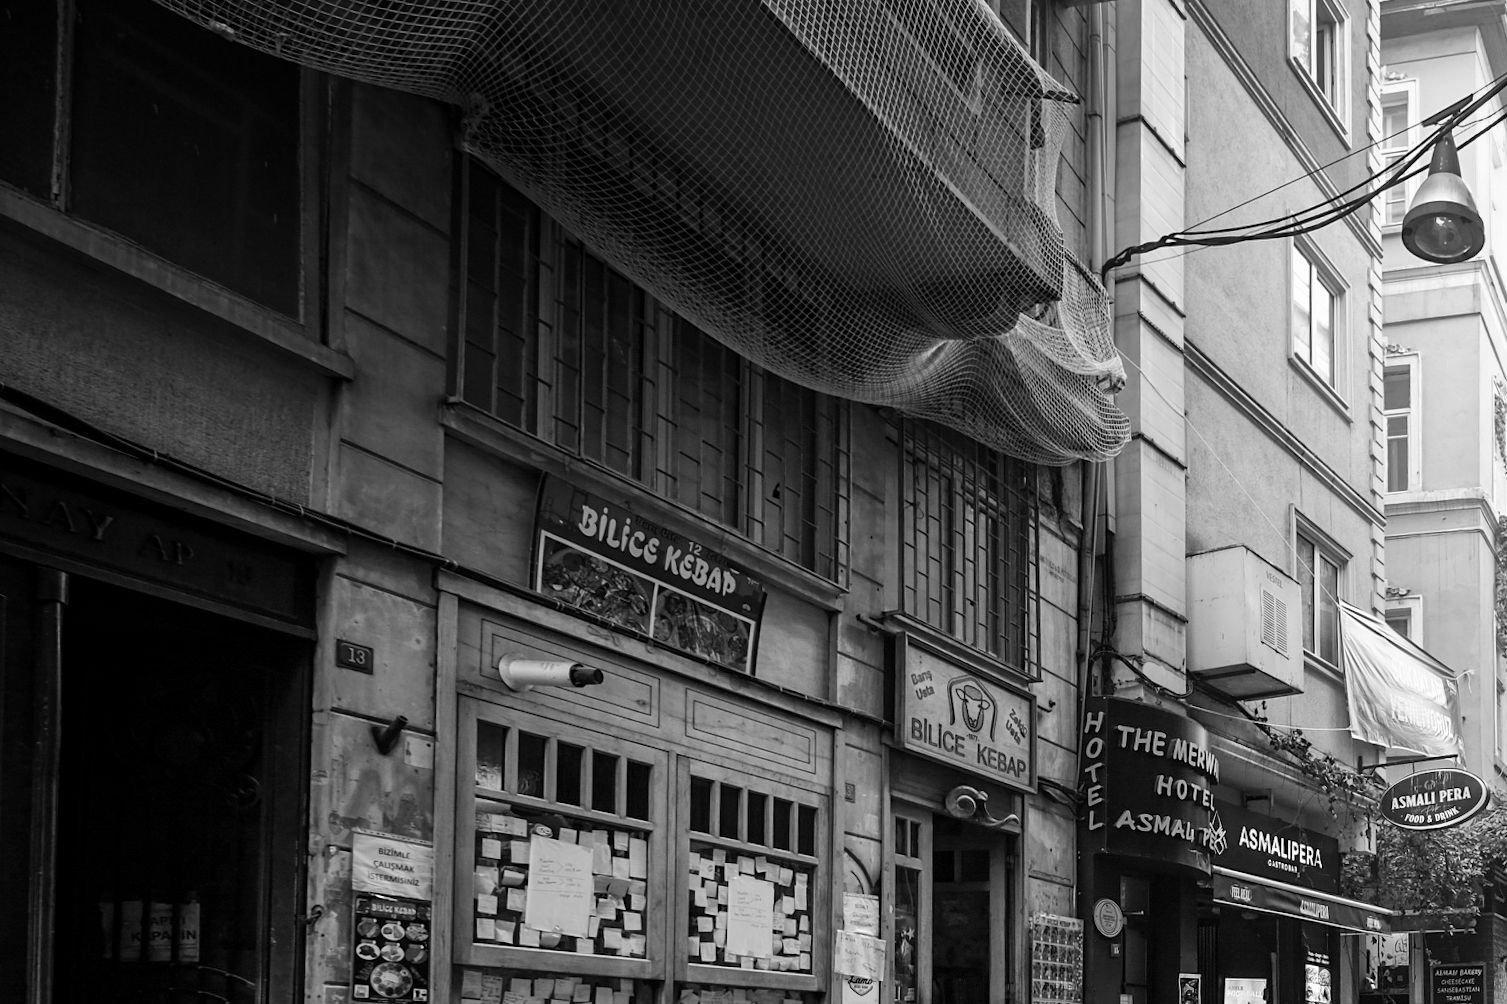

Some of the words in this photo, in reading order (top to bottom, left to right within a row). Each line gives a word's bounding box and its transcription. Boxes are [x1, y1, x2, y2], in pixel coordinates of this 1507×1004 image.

[578, 504, 660, 564] BİLİCE
[664, 544, 737, 597] KEBAP
[347, 647, 367, 665] 13
[915, 685, 936, 701] Usta
[1115, 724, 1167, 757] THE
[977, 743, 1027, 778] KEBAP
[1084, 711, 1105, 831] HOTEL
[1155, 774, 1215, 812] HOTEL
[1391, 791, 1436, 810] ASMALI
[1439, 785, 1472, 802] PERA
[1404, 813, 1425, 824] FOOD
[1427, 814, 1433, 823] &
[1434, 805, 1461, 822] DRINK
[1239, 825, 1323, 869] ASMALIPERA
